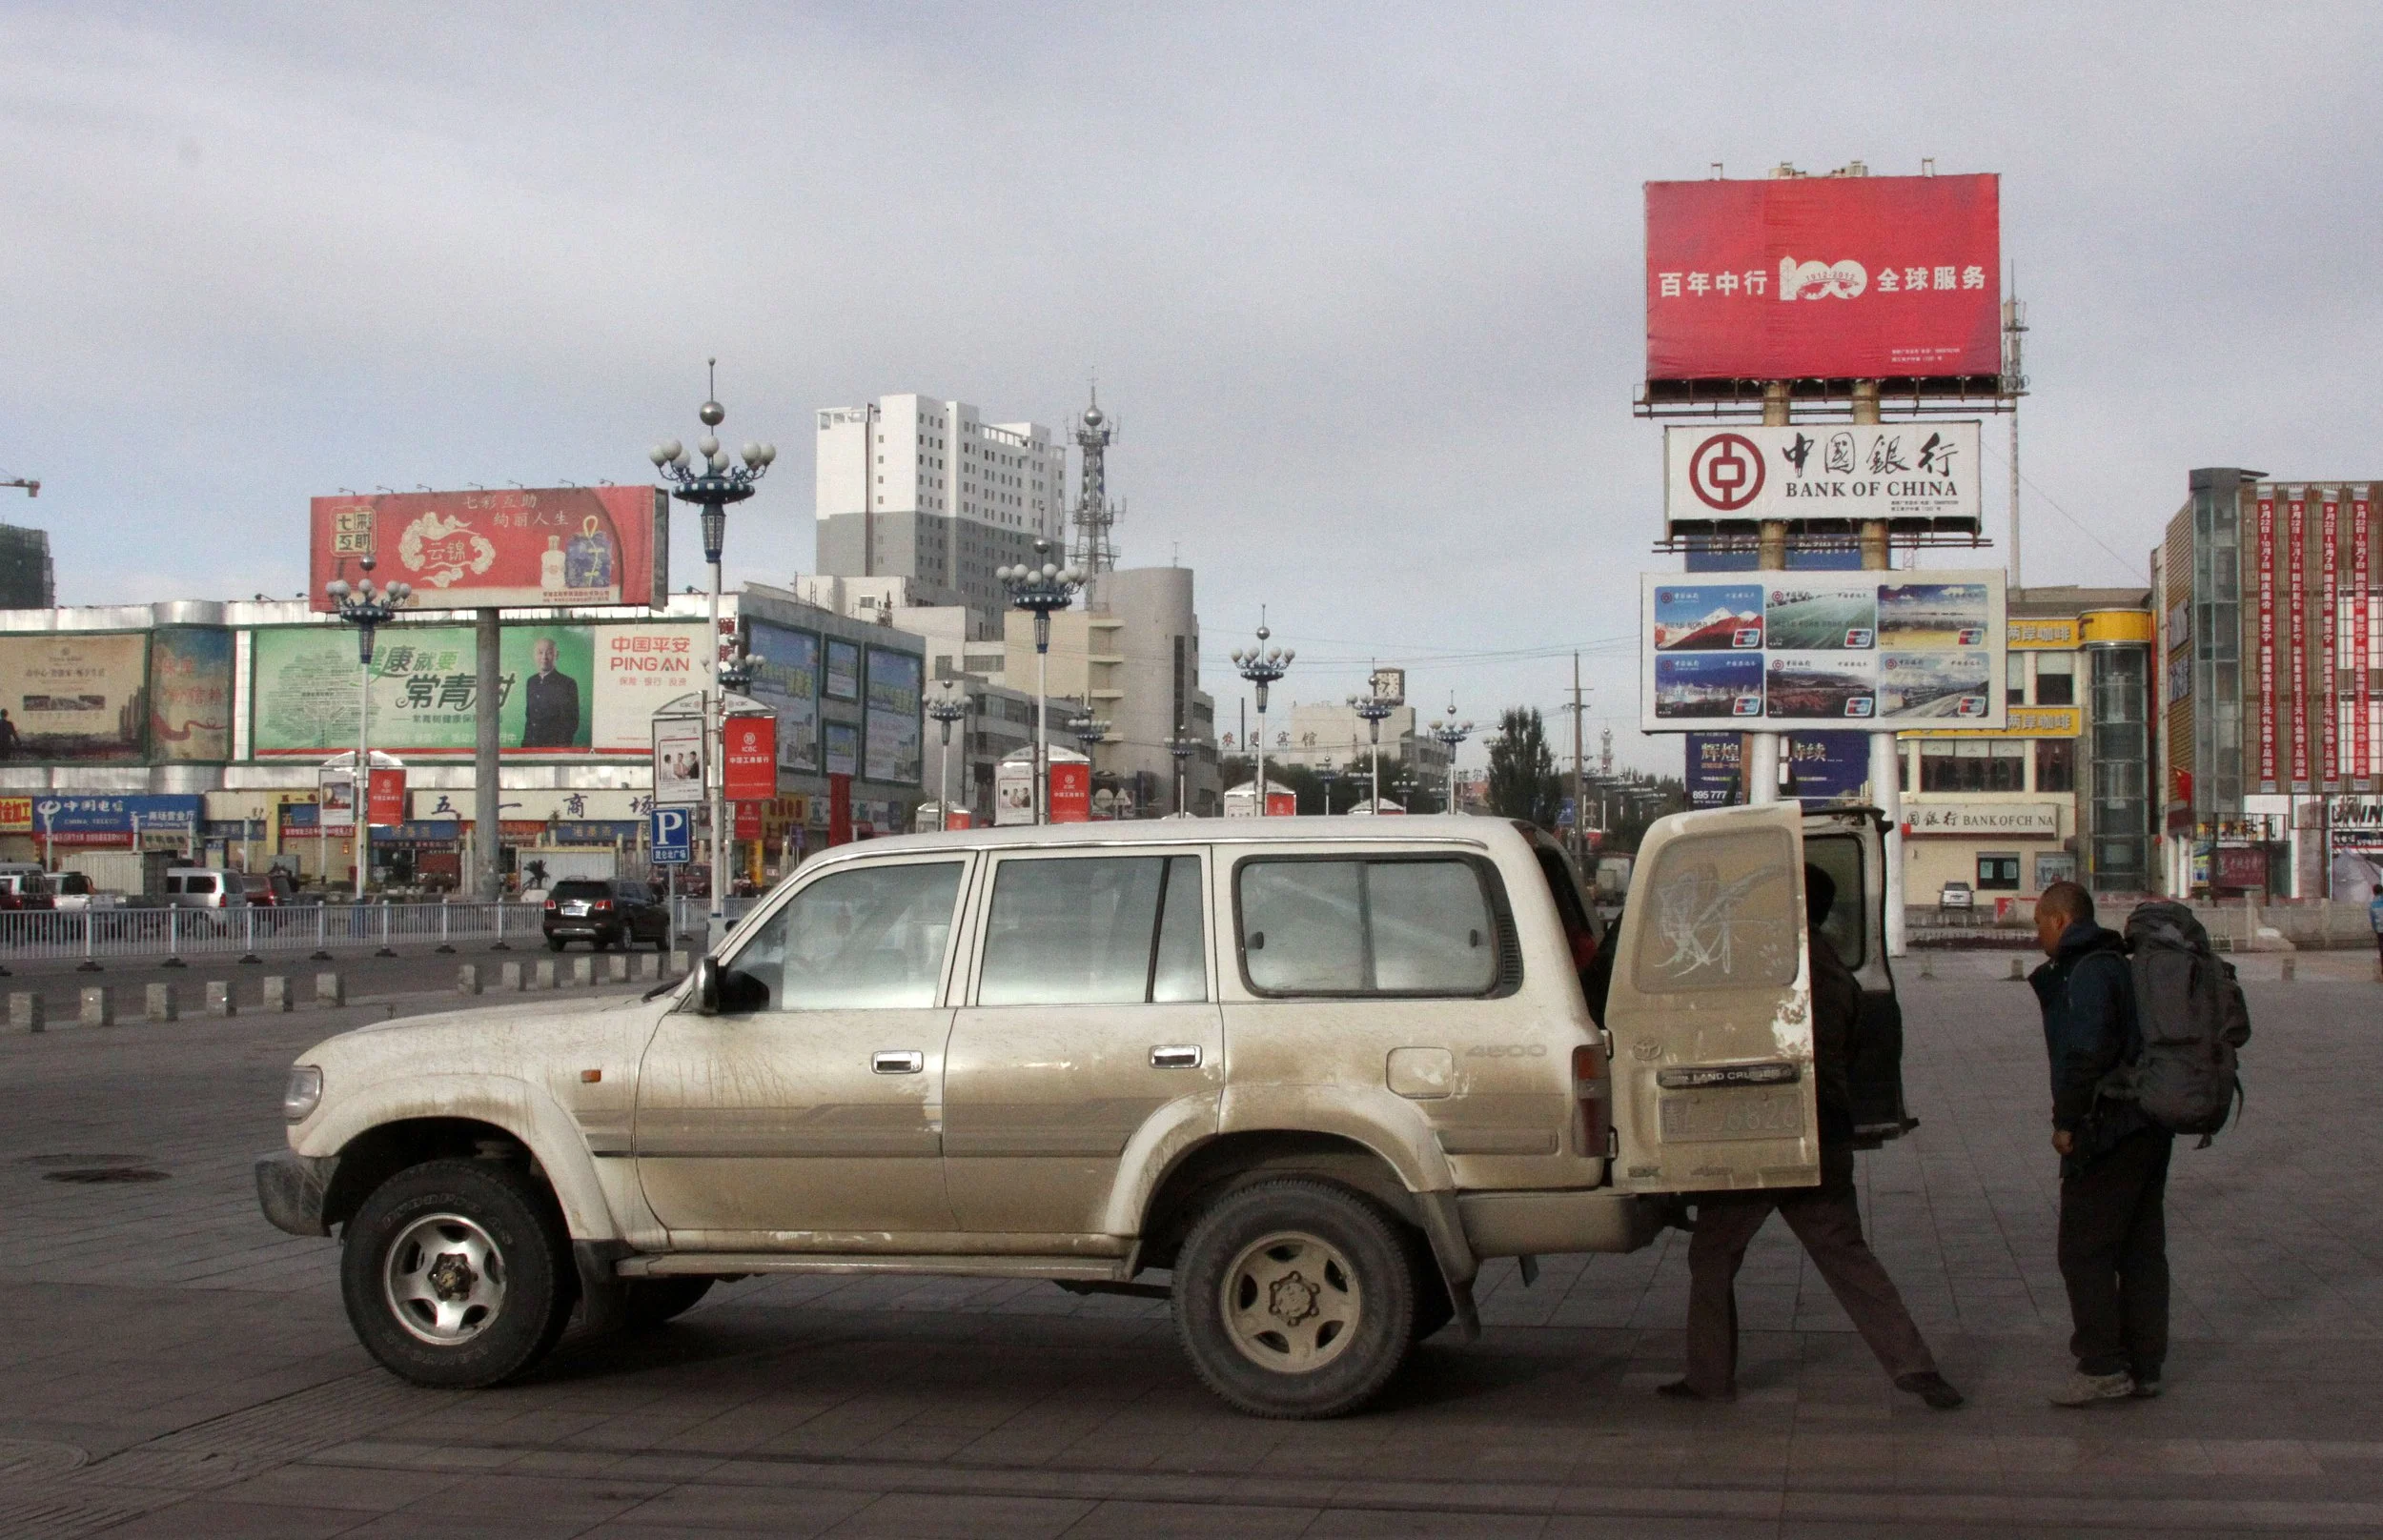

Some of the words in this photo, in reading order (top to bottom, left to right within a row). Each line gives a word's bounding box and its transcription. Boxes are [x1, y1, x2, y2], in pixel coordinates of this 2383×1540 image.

[1659, 271, 1767, 297] 百年中行
[1877, 265, 1986, 292] 全球服务
[1786, 482, 1846, 497] BANK
[1852, 482, 1881, 496] OF
[1887, 480, 1958, 496] CHINA
[463, 495, 537, 510] 七彩互助
[337, 514, 373, 531] 七彩
[494, 511, 569, 528] 绚丽人生
[337, 534, 370, 552] 互助
[427, 542, 465, 561] 云锦
[2007, 625, 2071, 642] 两岸咖啡
[611, 637, 690, 653] 中国平安
[2007, 714, 2071, 731] 两岸咖啡
[729, 756, 769, 764] 中国工商银行
[1701, 742, 1740, 761] 辉煌
[1693, 790, 1708, 800] 895
[63, 800, 124, 812] 中国电信
[656, 812, 682, 845] P
[1465, 1044, 1548, 1058] 4500
[1693, 1072, 1725, 1083] LAND
